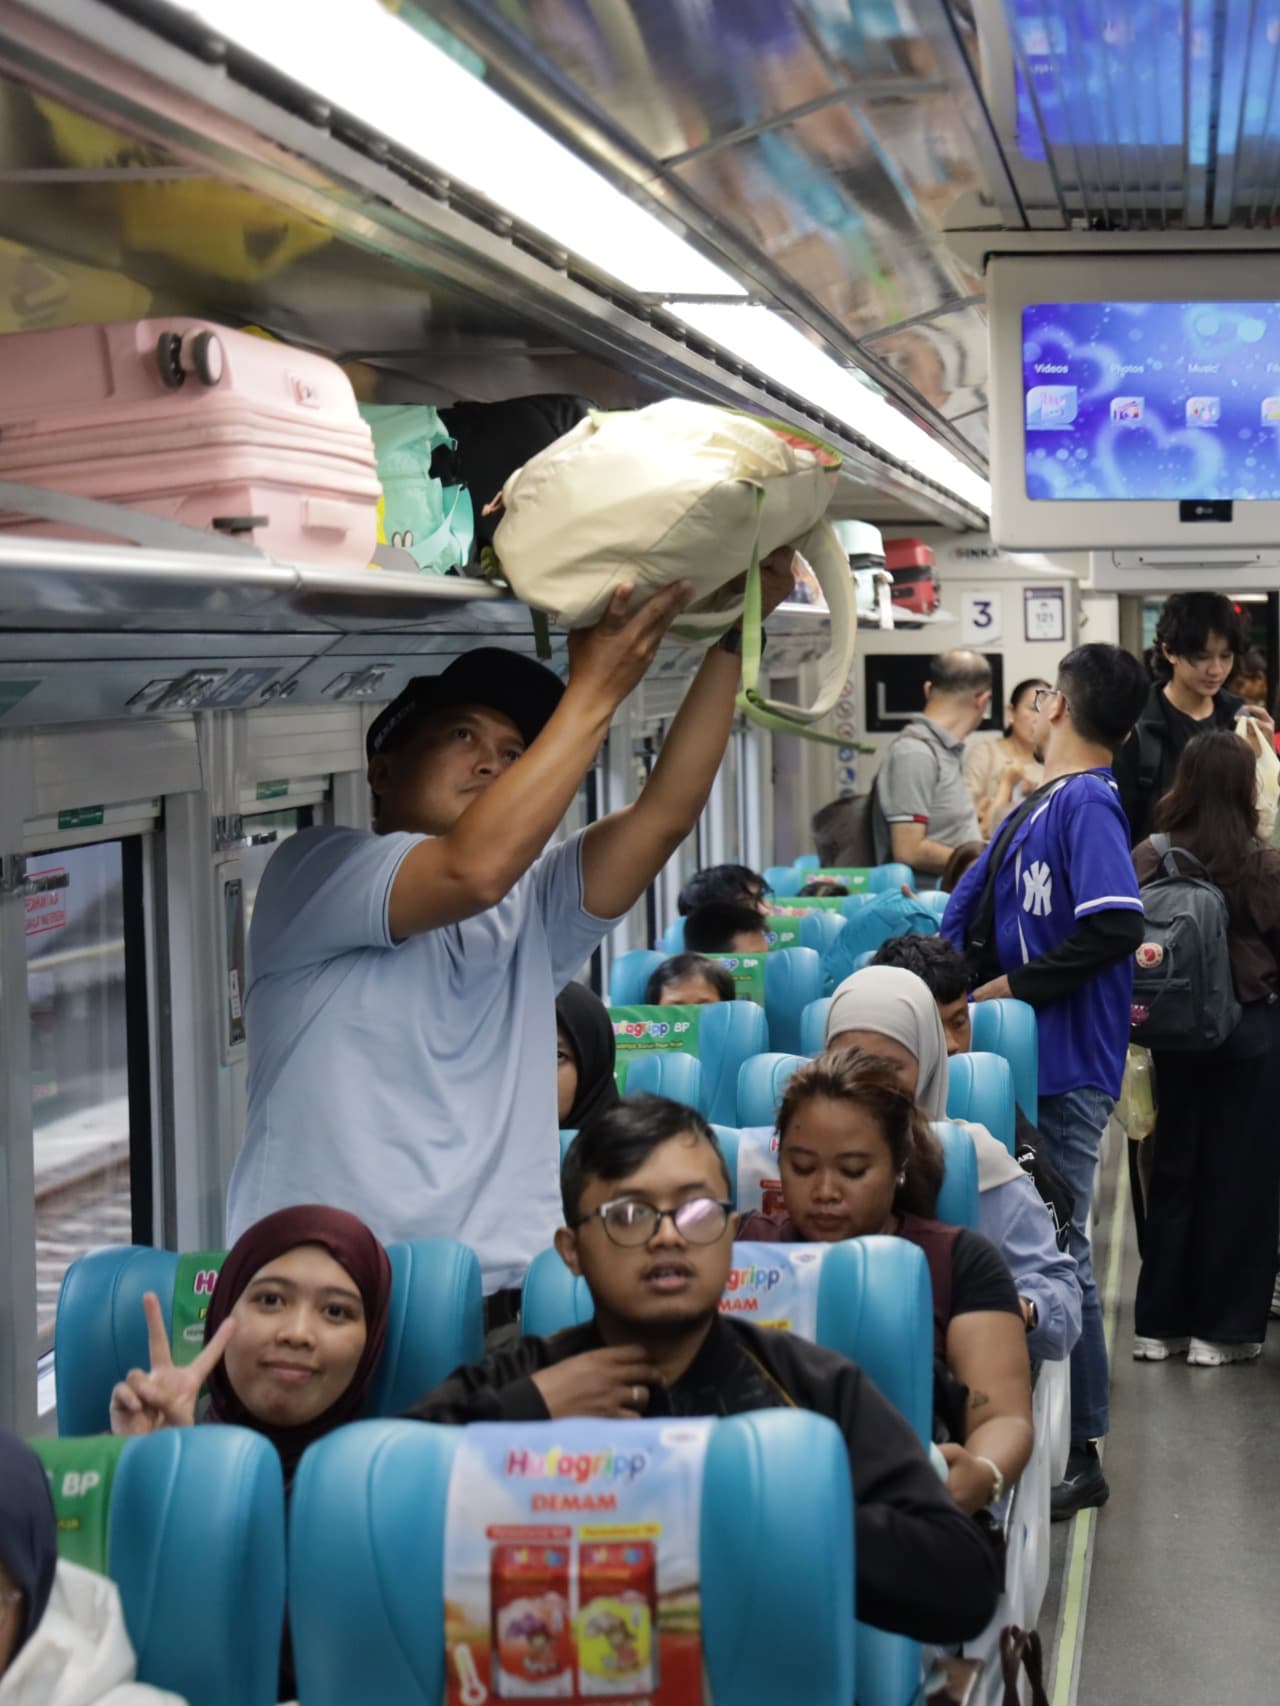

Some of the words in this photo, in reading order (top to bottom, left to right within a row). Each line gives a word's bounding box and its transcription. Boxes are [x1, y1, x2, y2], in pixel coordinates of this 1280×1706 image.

[1034, 362, 1069, 374] Videos
[1110, 362, 1144, 374] Photos
[972, 601, 992, 627] 3
[727, 1264, 781, 1291] gripp
[717, 1296, 760, 1312] MAM
[506, 1444, 646, 1484] Hufagripp
[62, 1471, 100, 1497] BP
[531, 1492, 617, 1512] DEMAM
